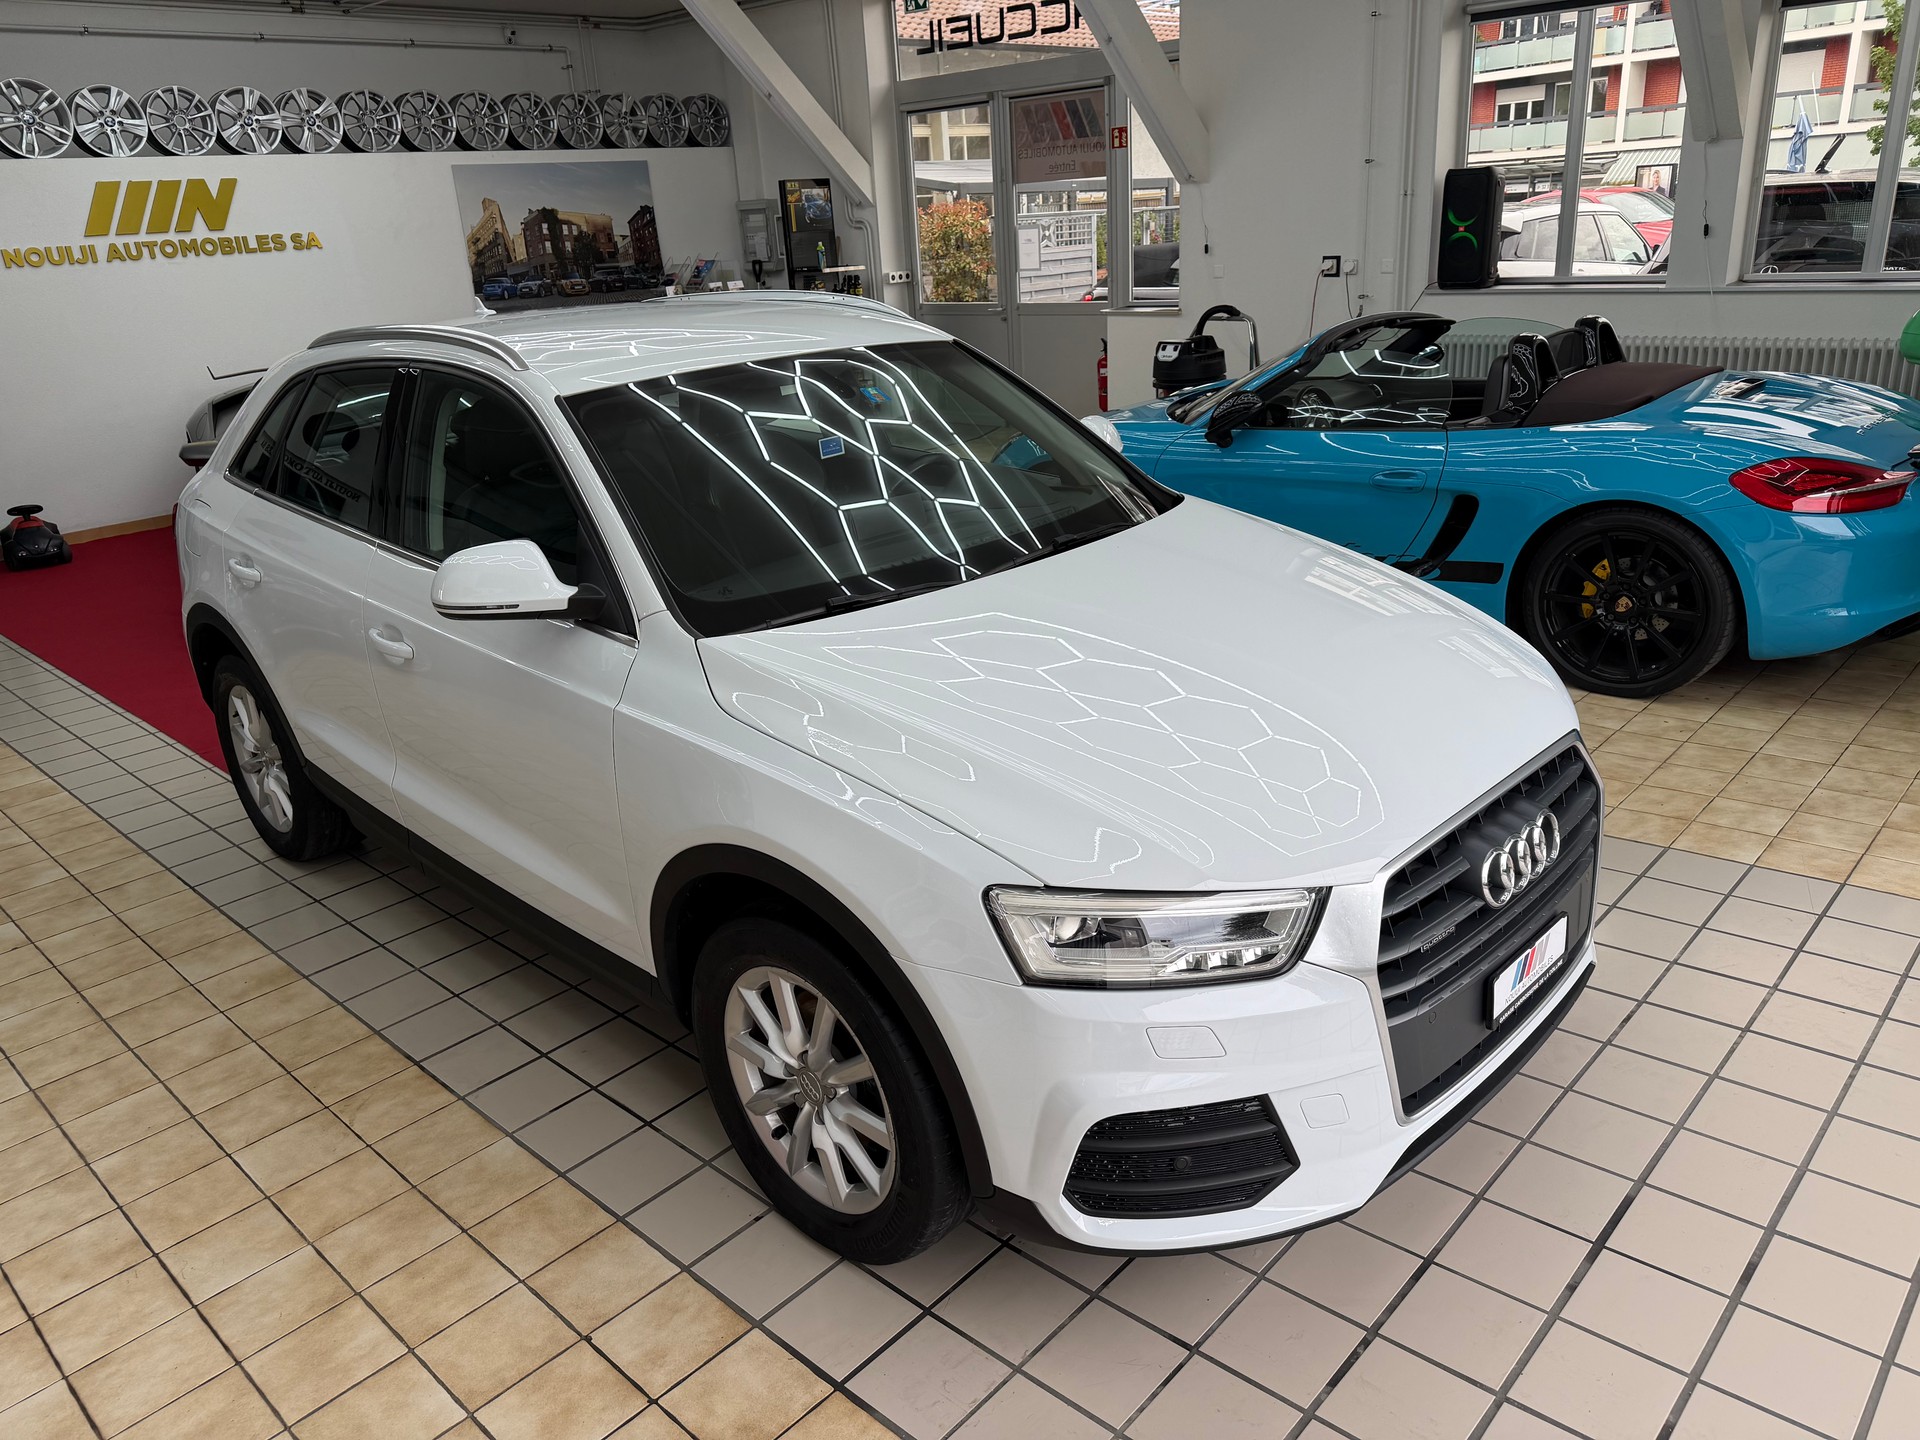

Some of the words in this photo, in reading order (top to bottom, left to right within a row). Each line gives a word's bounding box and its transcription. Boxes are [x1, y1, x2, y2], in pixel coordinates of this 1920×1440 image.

[1, 244, 99, 268] NOUIJI
[107, 233, 287, 263] AUTOMOBILES
[290, 231, 323, 250] SA
[1855, 409, 1901, 436] PORSCHE
